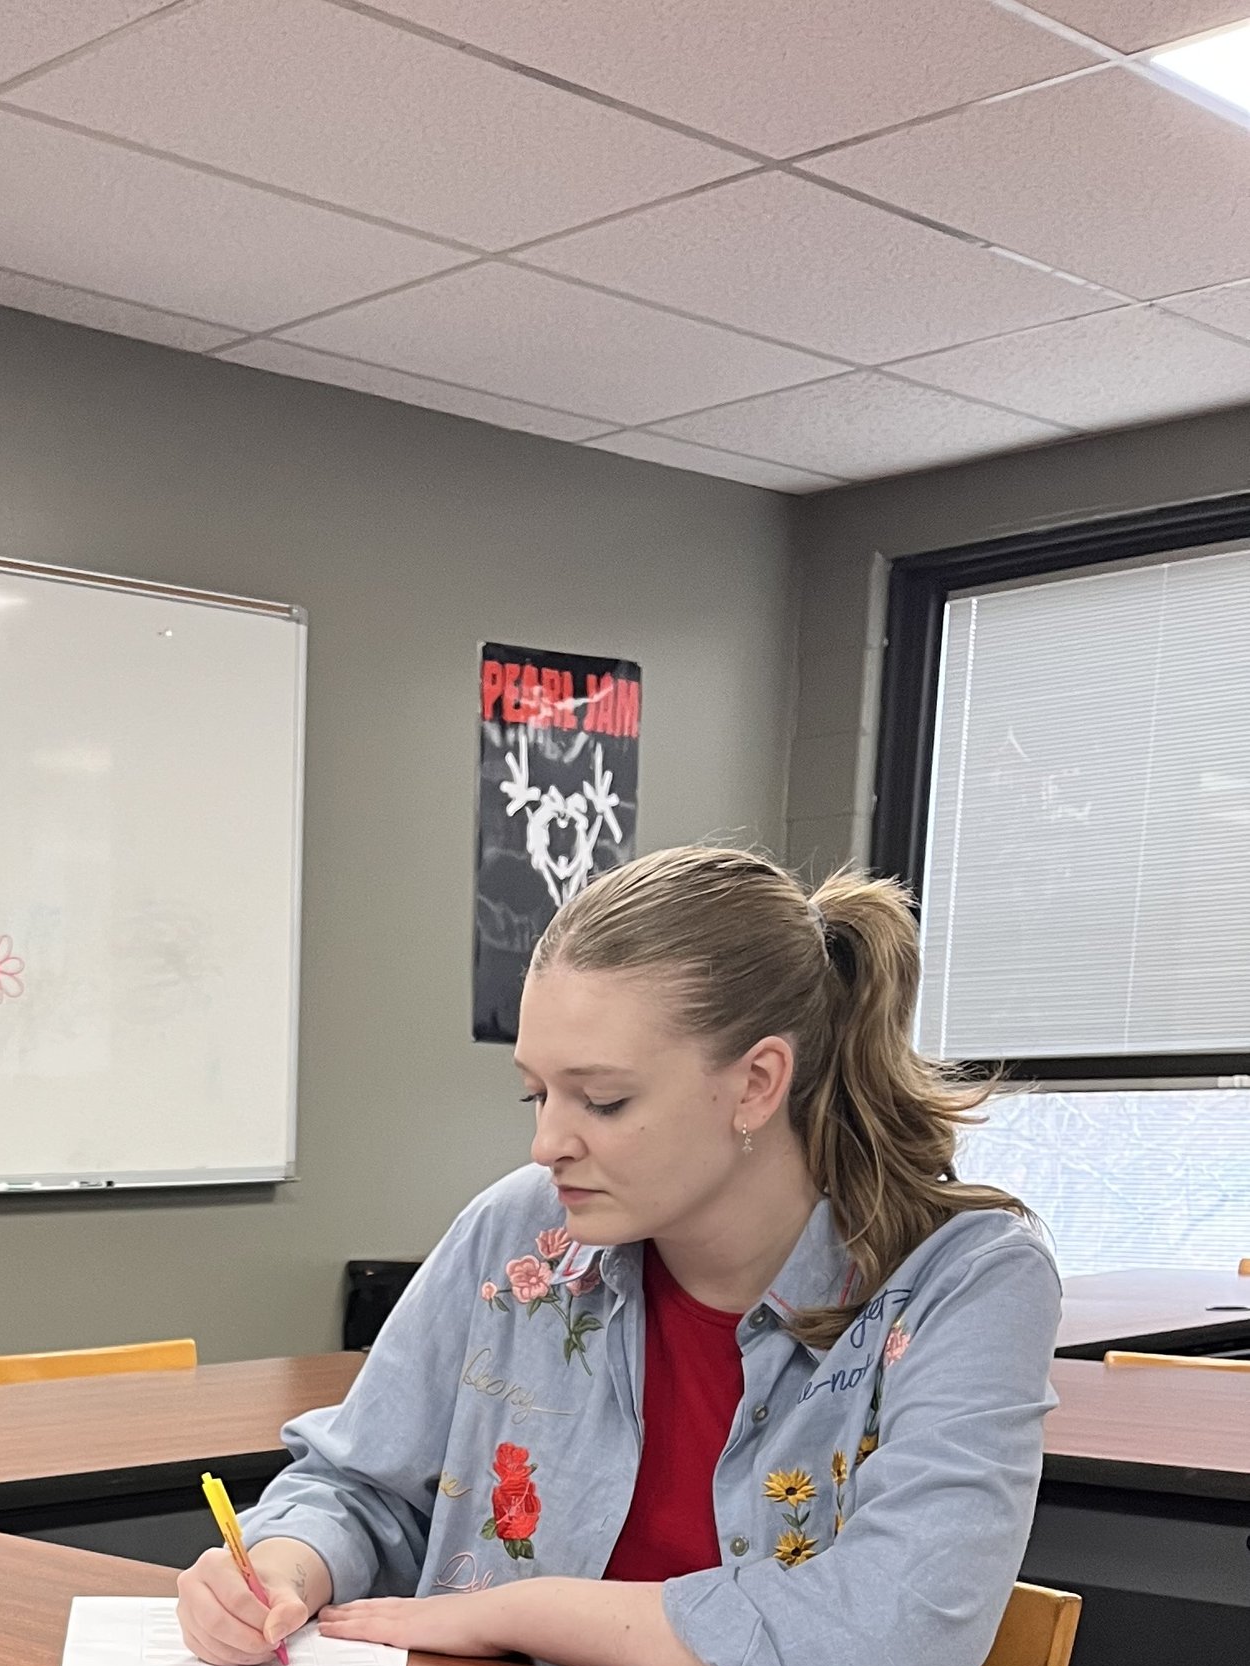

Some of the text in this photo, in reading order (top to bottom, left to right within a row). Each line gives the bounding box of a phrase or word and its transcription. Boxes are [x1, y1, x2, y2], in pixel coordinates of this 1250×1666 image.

[482, 660, 639, 739] PEARL JAM
[797, 1353, 874, 1404] e-not
